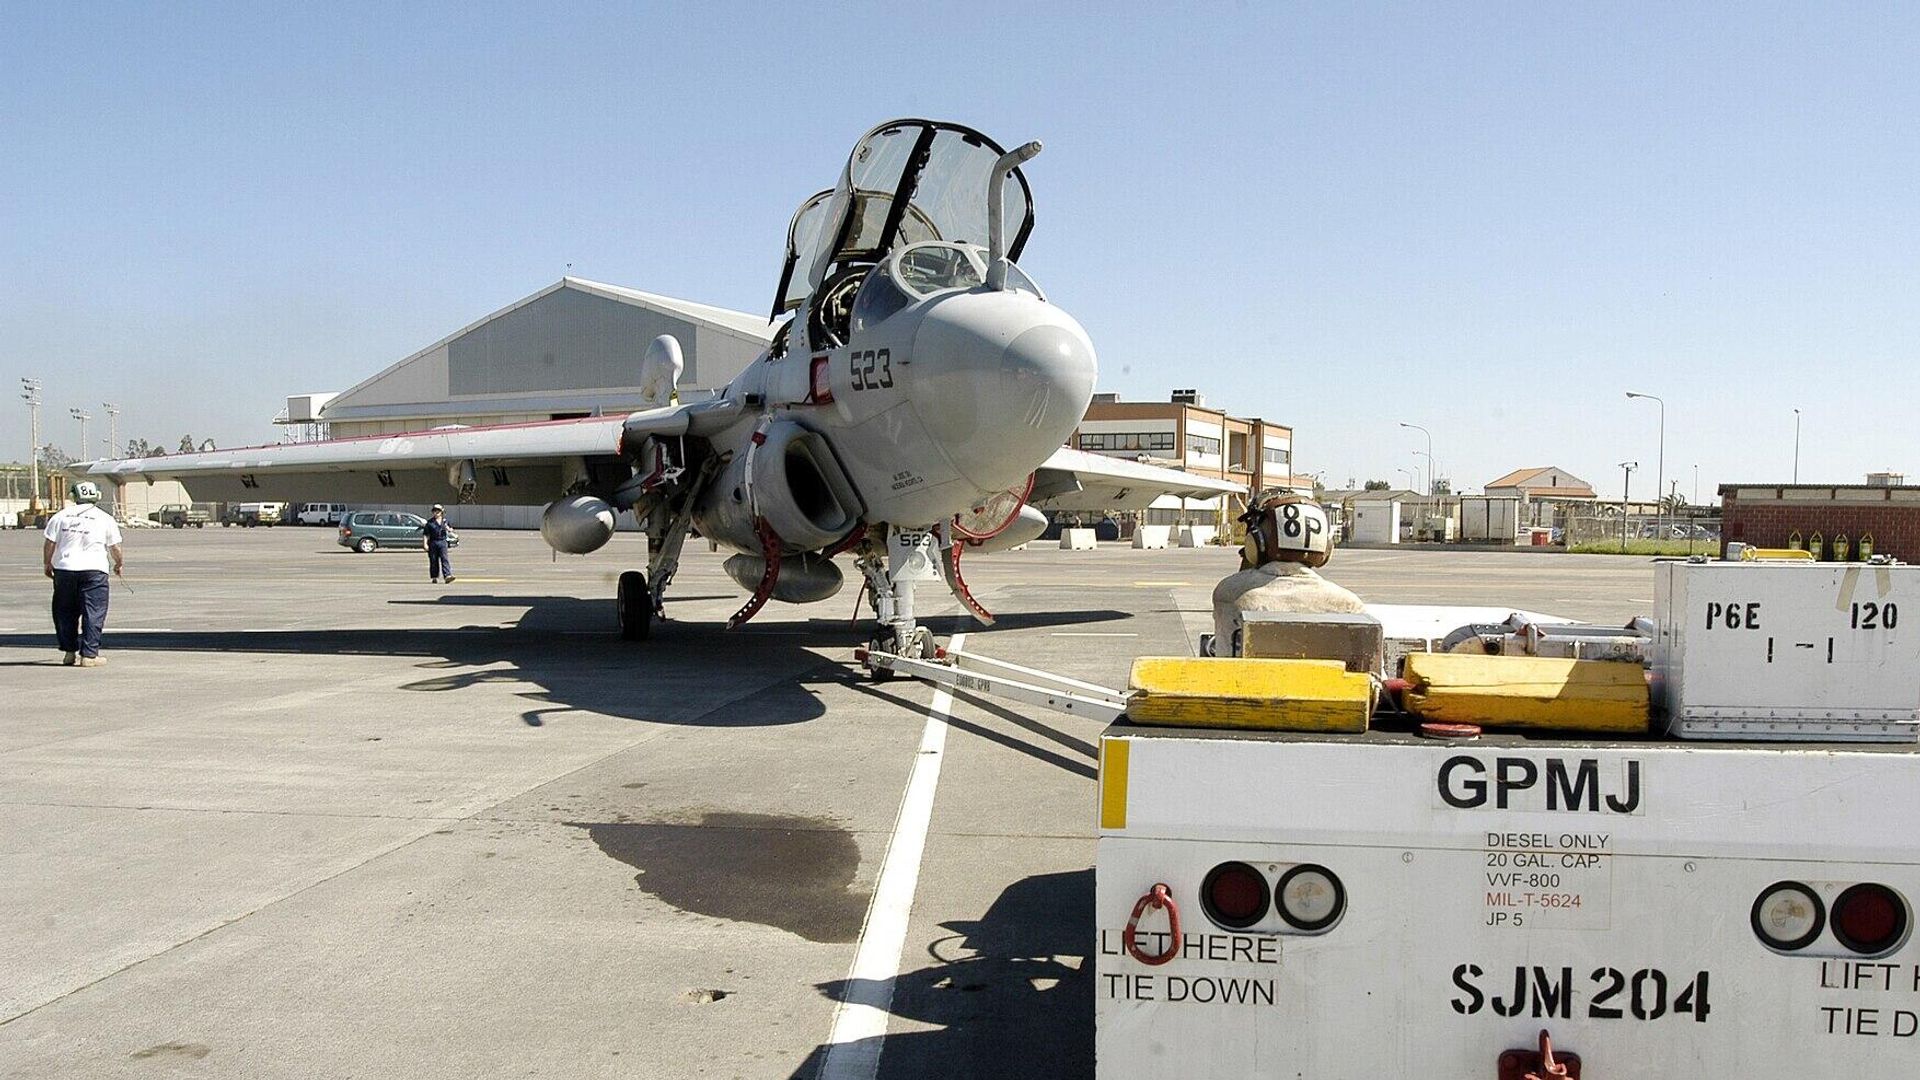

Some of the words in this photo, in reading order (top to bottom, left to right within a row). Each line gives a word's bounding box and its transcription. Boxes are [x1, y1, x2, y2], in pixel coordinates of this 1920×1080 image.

[851, 348, 894, 391] 523
[81, 486, 95, 495] 8L
[1283, 504, 1322, 548] 8P
[1706, 602, 1760, 630] P6E
[1851, 602, 1898, 630] 120
[1437, 755, 1641, 814] GPMJ
[1487, 833, 1553, 848] DIESEL
[1559, 833, 1609, 849] ONLY
[1487, 852, 1507, 867] 20
[1513, 853, 1554, 868] GAL.
[1561, 853, 1602, 869] CAP.
[1486, 872, 1560, 888] VVF-800
[1486, 892, 1581, 908] MIL-T-5624
[1486, 912, 1507, 926] JP
[1513, 912, 1523, 927] 5
[1183, 933, 1278, 964] HERE
[1103, 973, 1154, 1000] TIE
[1168, 976, 1274, 1006] DOWN
[1820, 961, 1901, 990] LIFT
[1821, 1006, 1879, 1036] TIE
